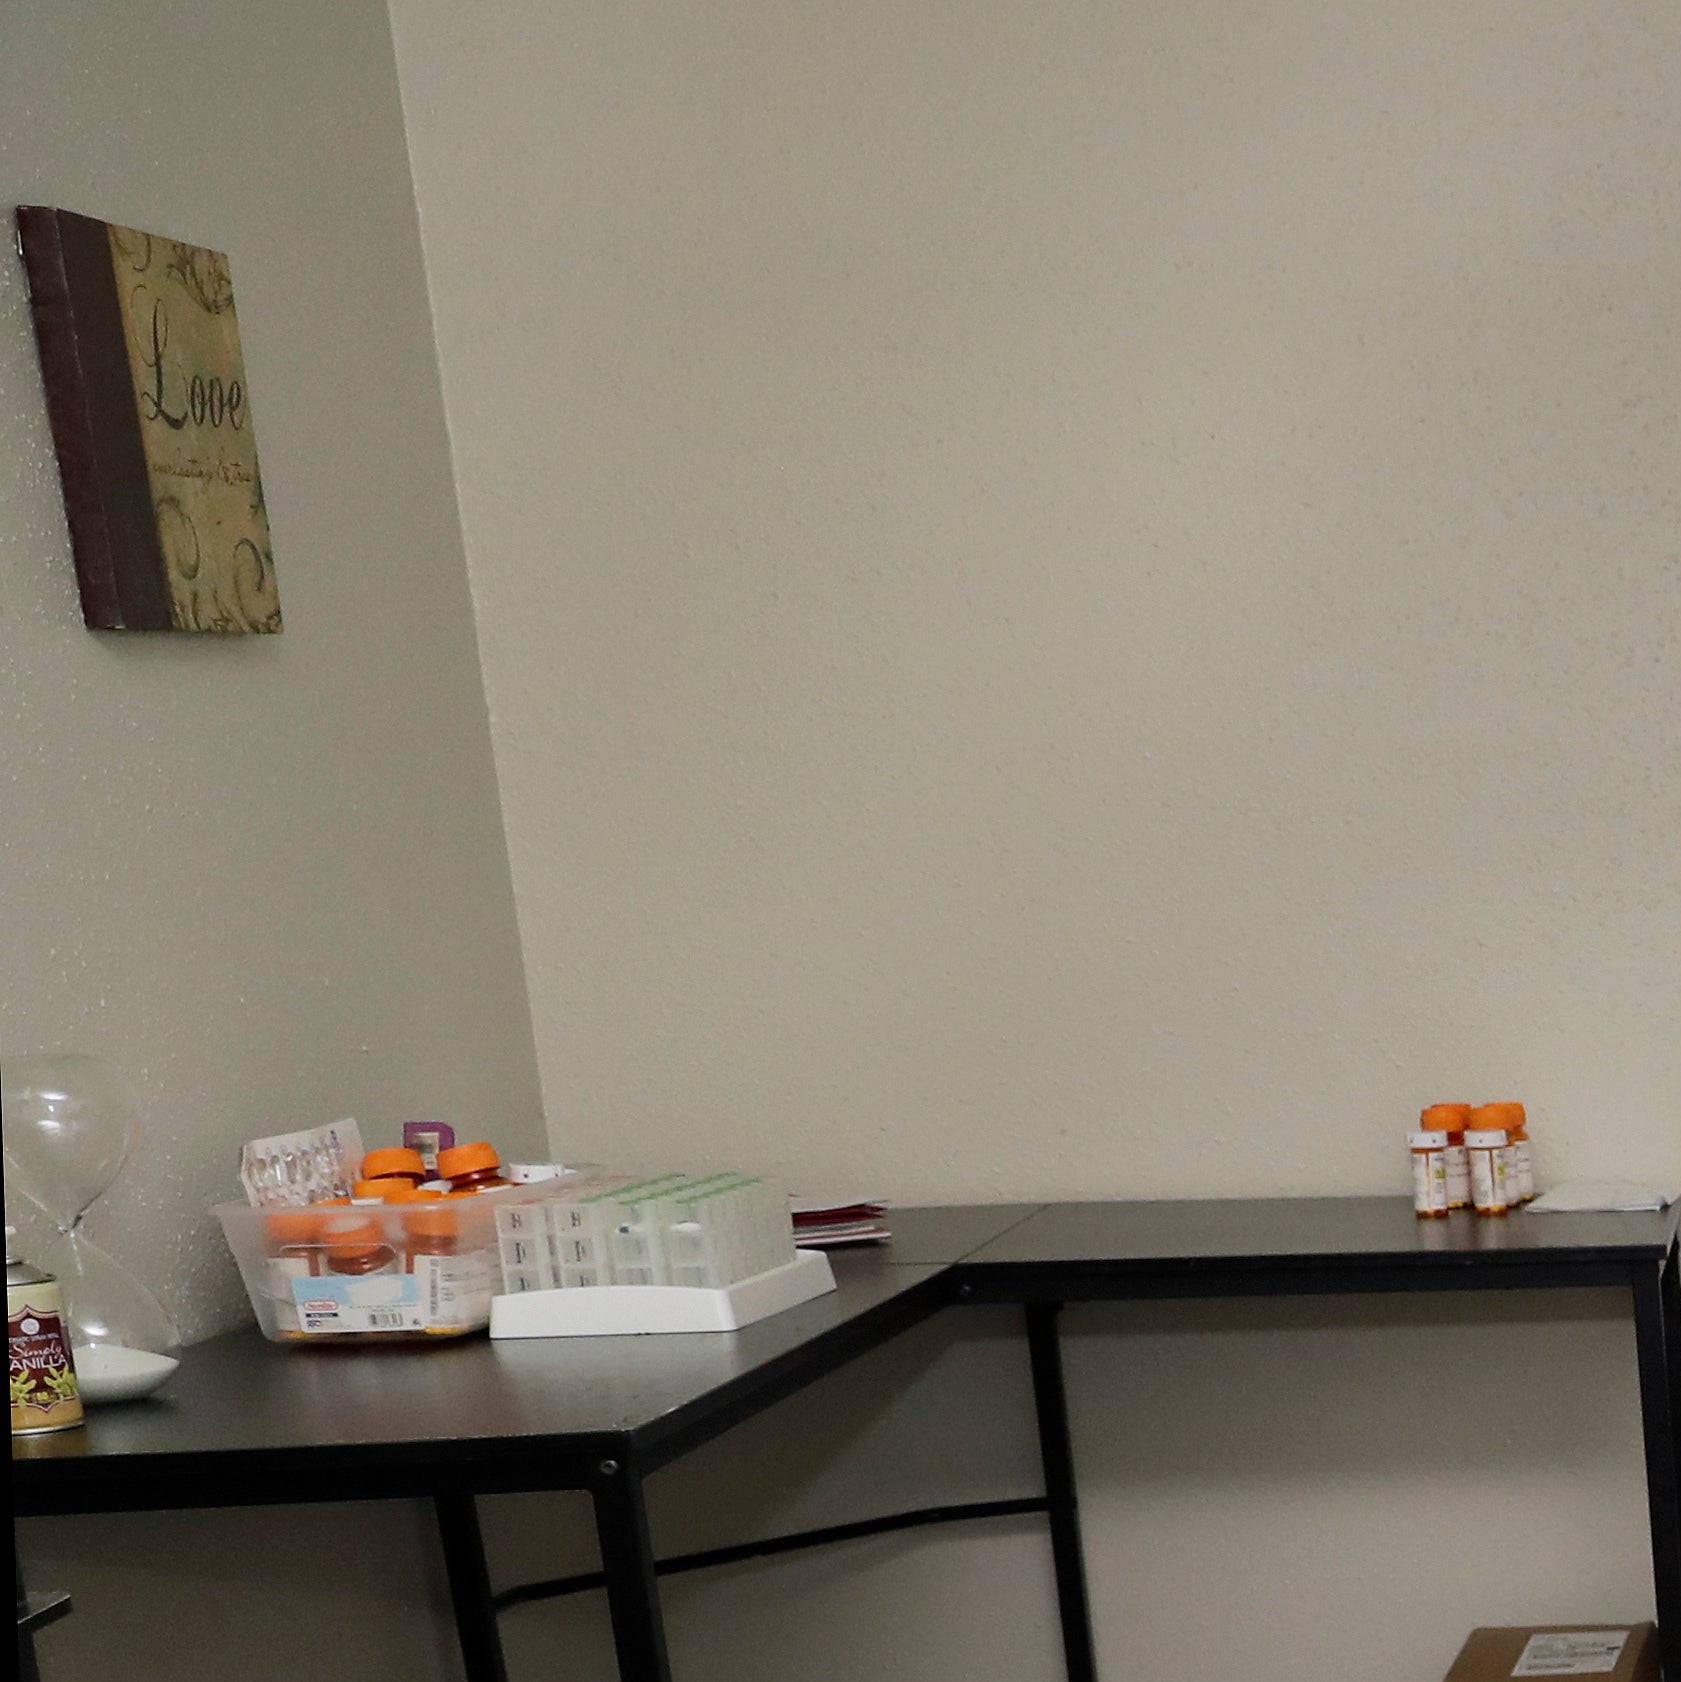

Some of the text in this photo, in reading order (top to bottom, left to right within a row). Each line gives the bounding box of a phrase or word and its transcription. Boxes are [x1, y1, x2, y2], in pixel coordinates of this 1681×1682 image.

[137, 298, 246, 431] Love
[9, 1340, 62, 1361] Simply
[10, 1354, 68, 1371] ANILLA
